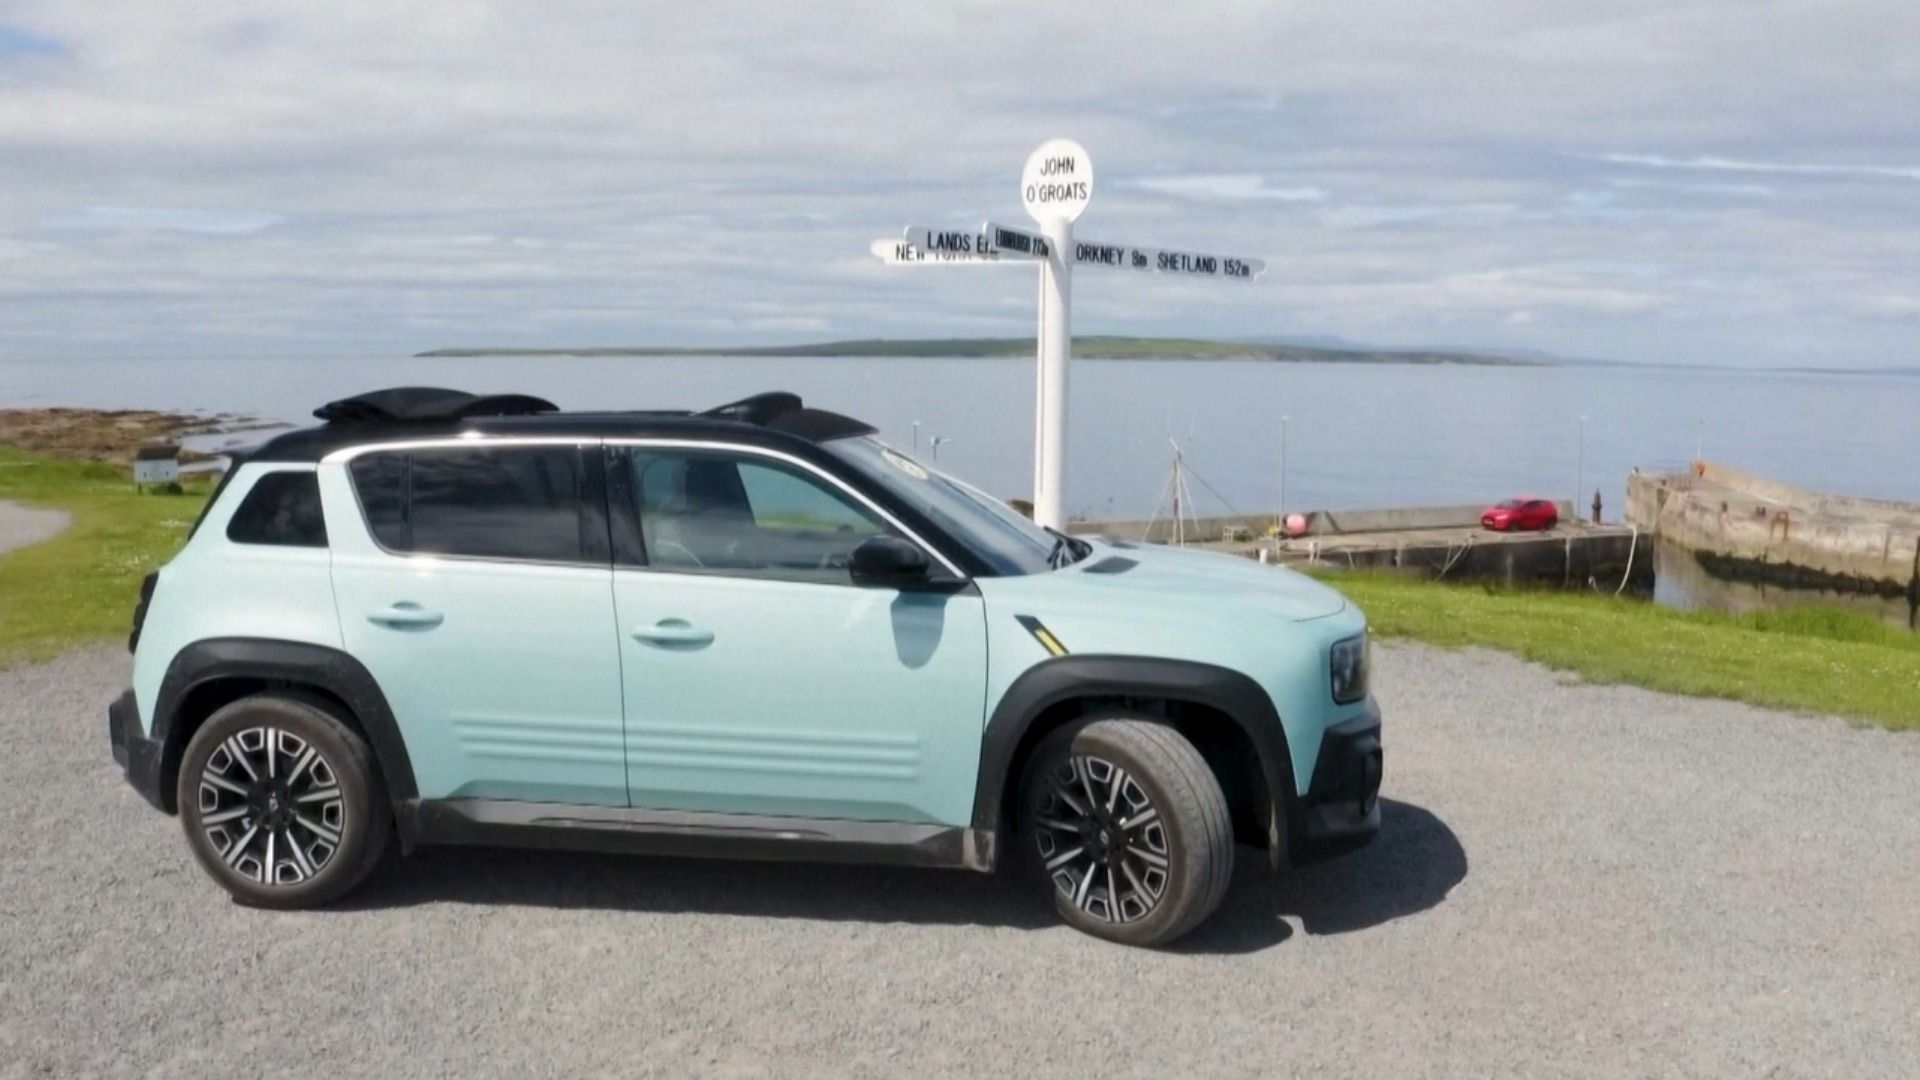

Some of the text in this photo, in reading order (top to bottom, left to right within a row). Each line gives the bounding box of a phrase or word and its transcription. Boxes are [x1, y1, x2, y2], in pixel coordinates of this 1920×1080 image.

[1040, 156, 1075, 176] JOHN
[1026, 181, 1087, 202] O'GROATS
[927, 231, 972, 252] LANDS
[1076, 243, 1124, 265] ORKNEY
[1157, 252, 1217, 274] SHETLAND
[1223, 259, 1250, 277] 152m
